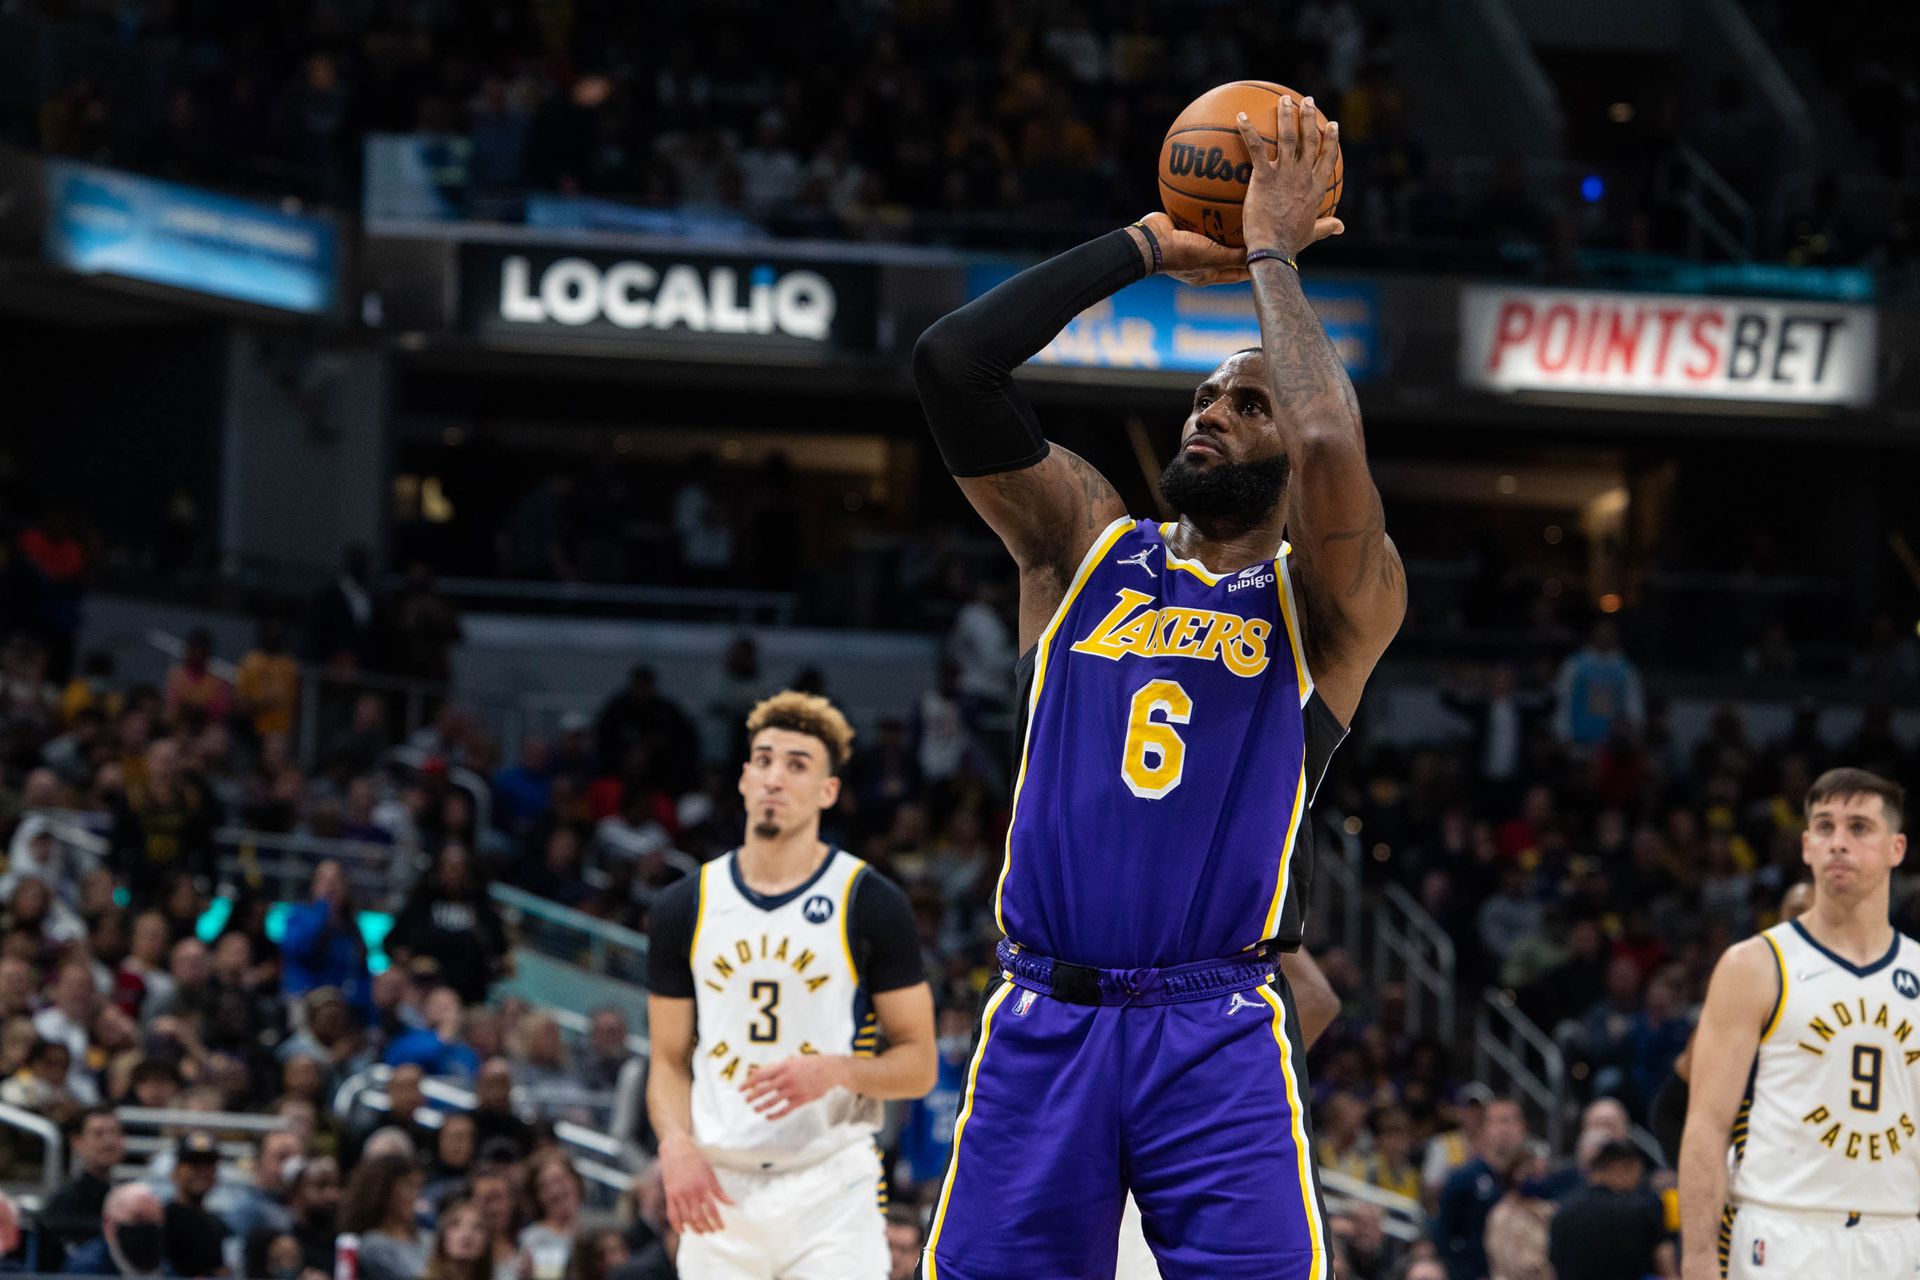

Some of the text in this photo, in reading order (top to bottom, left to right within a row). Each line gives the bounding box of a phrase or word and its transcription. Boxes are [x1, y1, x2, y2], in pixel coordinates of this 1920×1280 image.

[1168, 142, 1252, 185] Wilso
[1488, 301, 1847, 386] POINTSBET
[1227, 573, 1275, 593] bibigo
[1070, 587, 1273, 678] LAKERS
[1121, 678, 1193, 800] 6
[705, 935, 830, 993] INDIANA
[750, 979, 780, 1044] 3
[1798, 998, 1920, 1066] INDIANA
[1851, 1043, 1883, 1113] 9
[1803, 1104, 1916, 1161] PACERS
